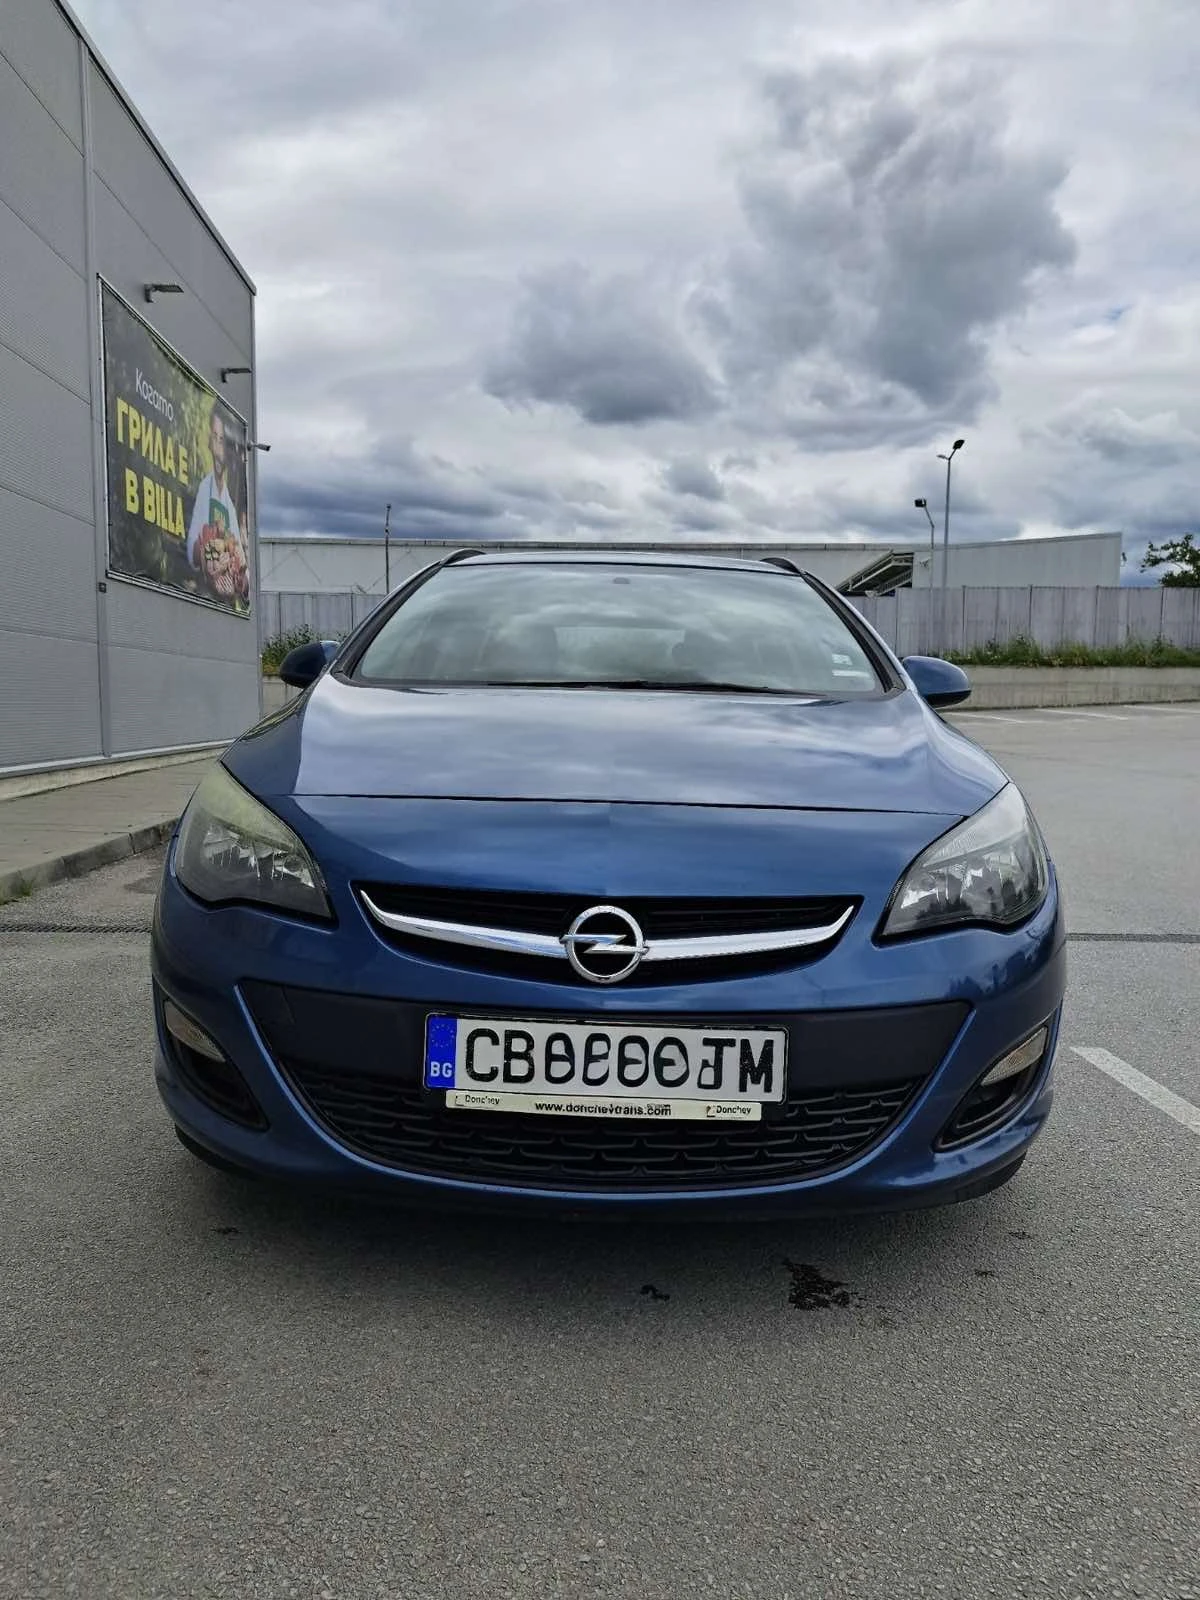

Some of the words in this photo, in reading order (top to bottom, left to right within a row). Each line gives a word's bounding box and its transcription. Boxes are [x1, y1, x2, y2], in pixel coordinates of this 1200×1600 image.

[117, 397, 176, 478] ГРИЛА
[143, 475, 186, 539] BILLA
[430, 1061, 453, 1078] BG
